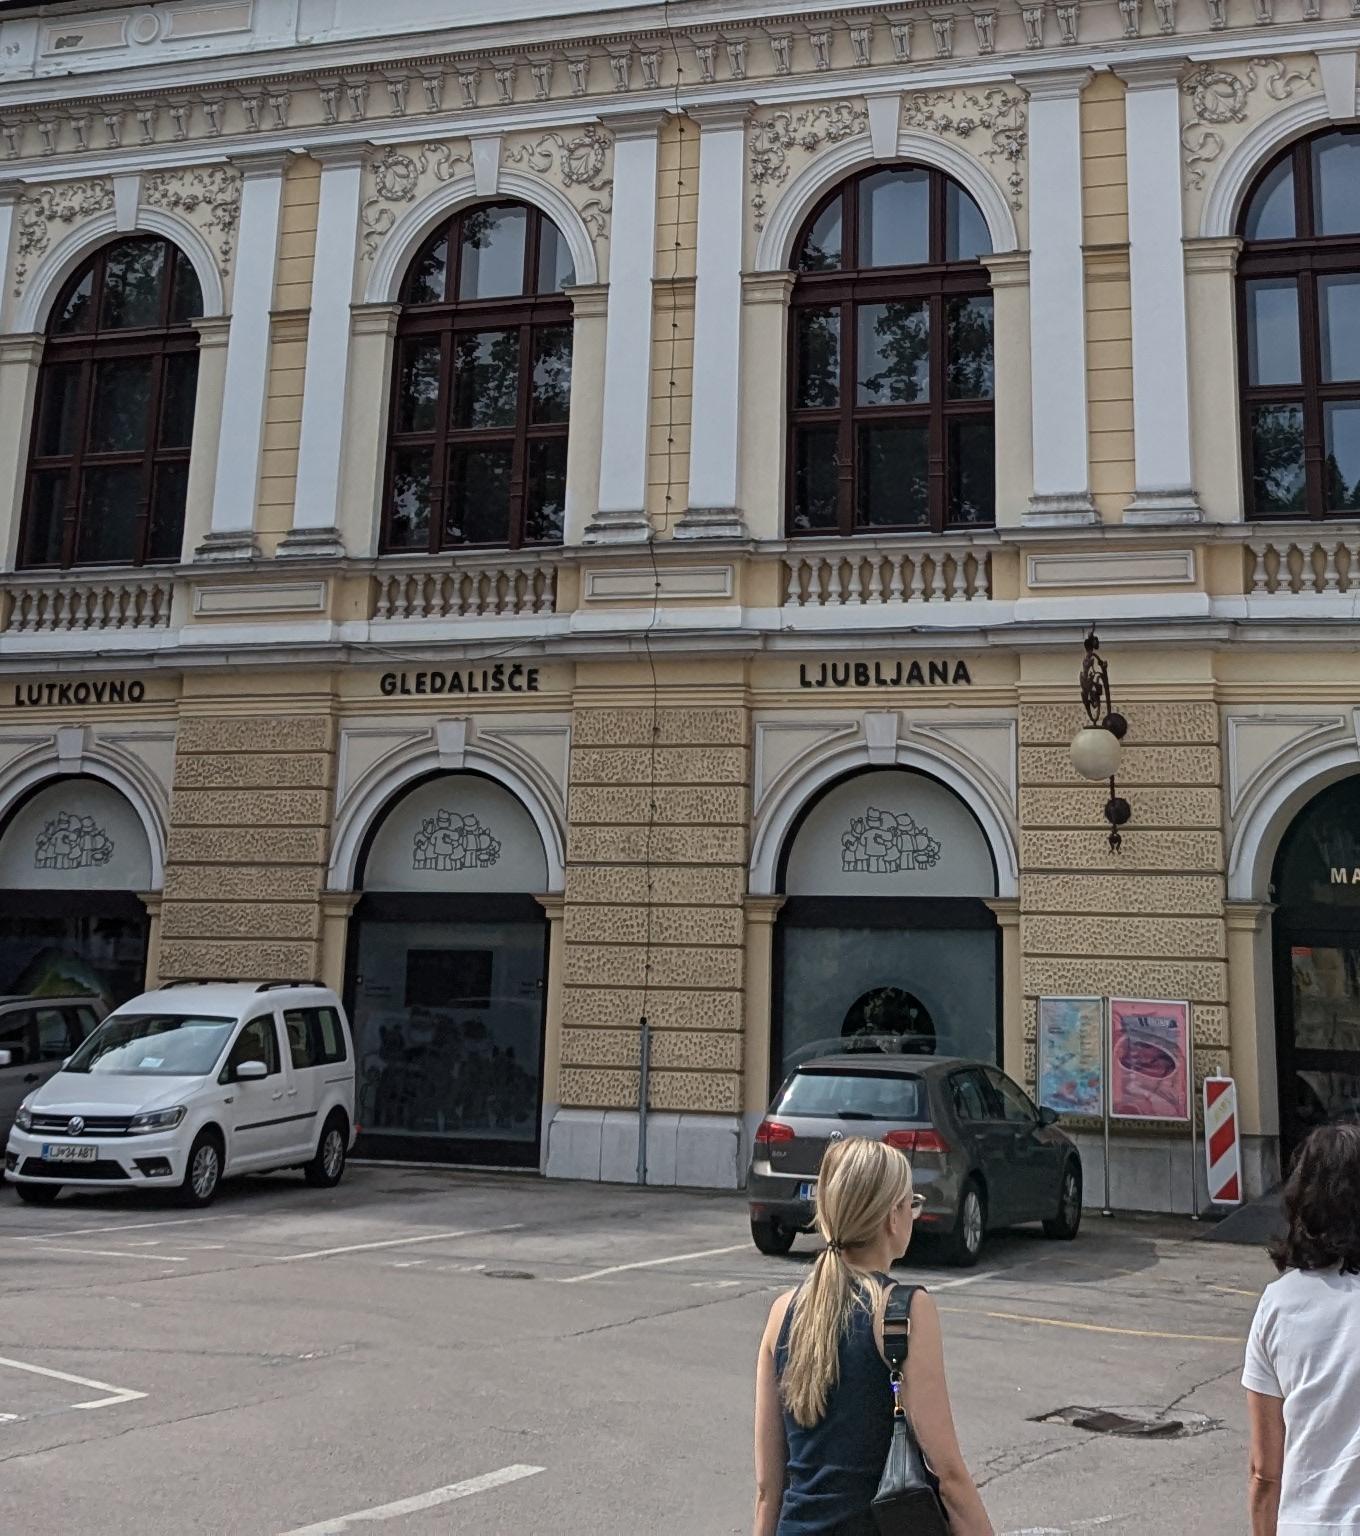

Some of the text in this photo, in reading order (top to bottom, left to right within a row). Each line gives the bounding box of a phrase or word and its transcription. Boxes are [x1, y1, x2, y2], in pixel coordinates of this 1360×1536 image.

[380, 664, 539, 696] GLEDALIŠČE
[799, 660, 971, 688] LJUBLJANA
[15, 680, 145, 706] LUTKOVNO
